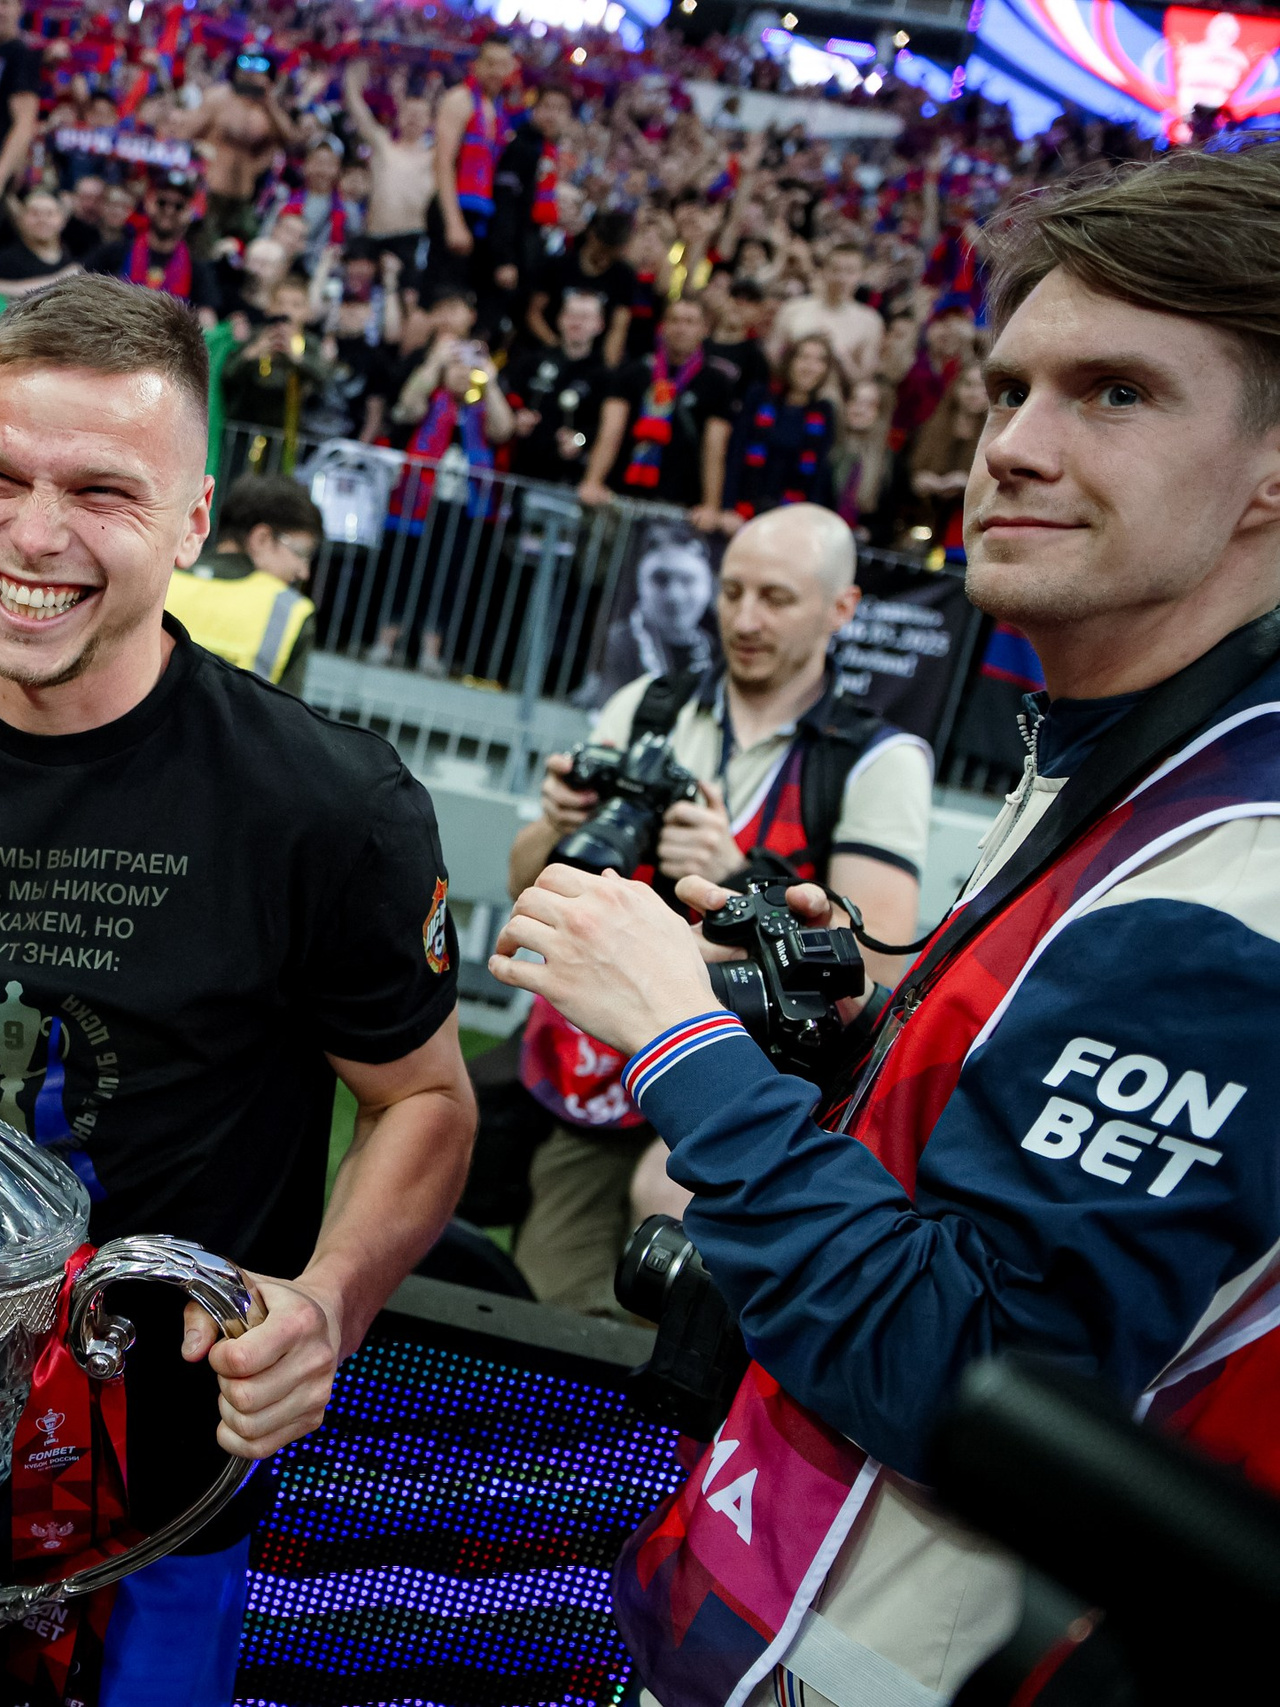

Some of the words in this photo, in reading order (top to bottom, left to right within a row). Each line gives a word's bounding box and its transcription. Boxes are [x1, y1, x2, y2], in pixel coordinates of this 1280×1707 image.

[47, 847, 189, 876] ВЫИГРАЕМ
[8, 879, 47, 901] МЫ
[51, 879, 169, 907] НИКОМУ
[94, 915, 135, 940] НО
[21, 942, 121, 972] ЗНАКИ:
[775, 939, 790, 968] Nikon
[59, 993, 111, 1047] ЦСКА
[4, 1020, 24, 1050] 9
[1041, 1036, 1248, 1139] FON
[1020, 1095, 1224, 1198] BET
[28, 1445, 76, 1462] FONBET
[49, 1456, 80, 1465] РОССИИ
[22, 1615, 65, 1642] BET
